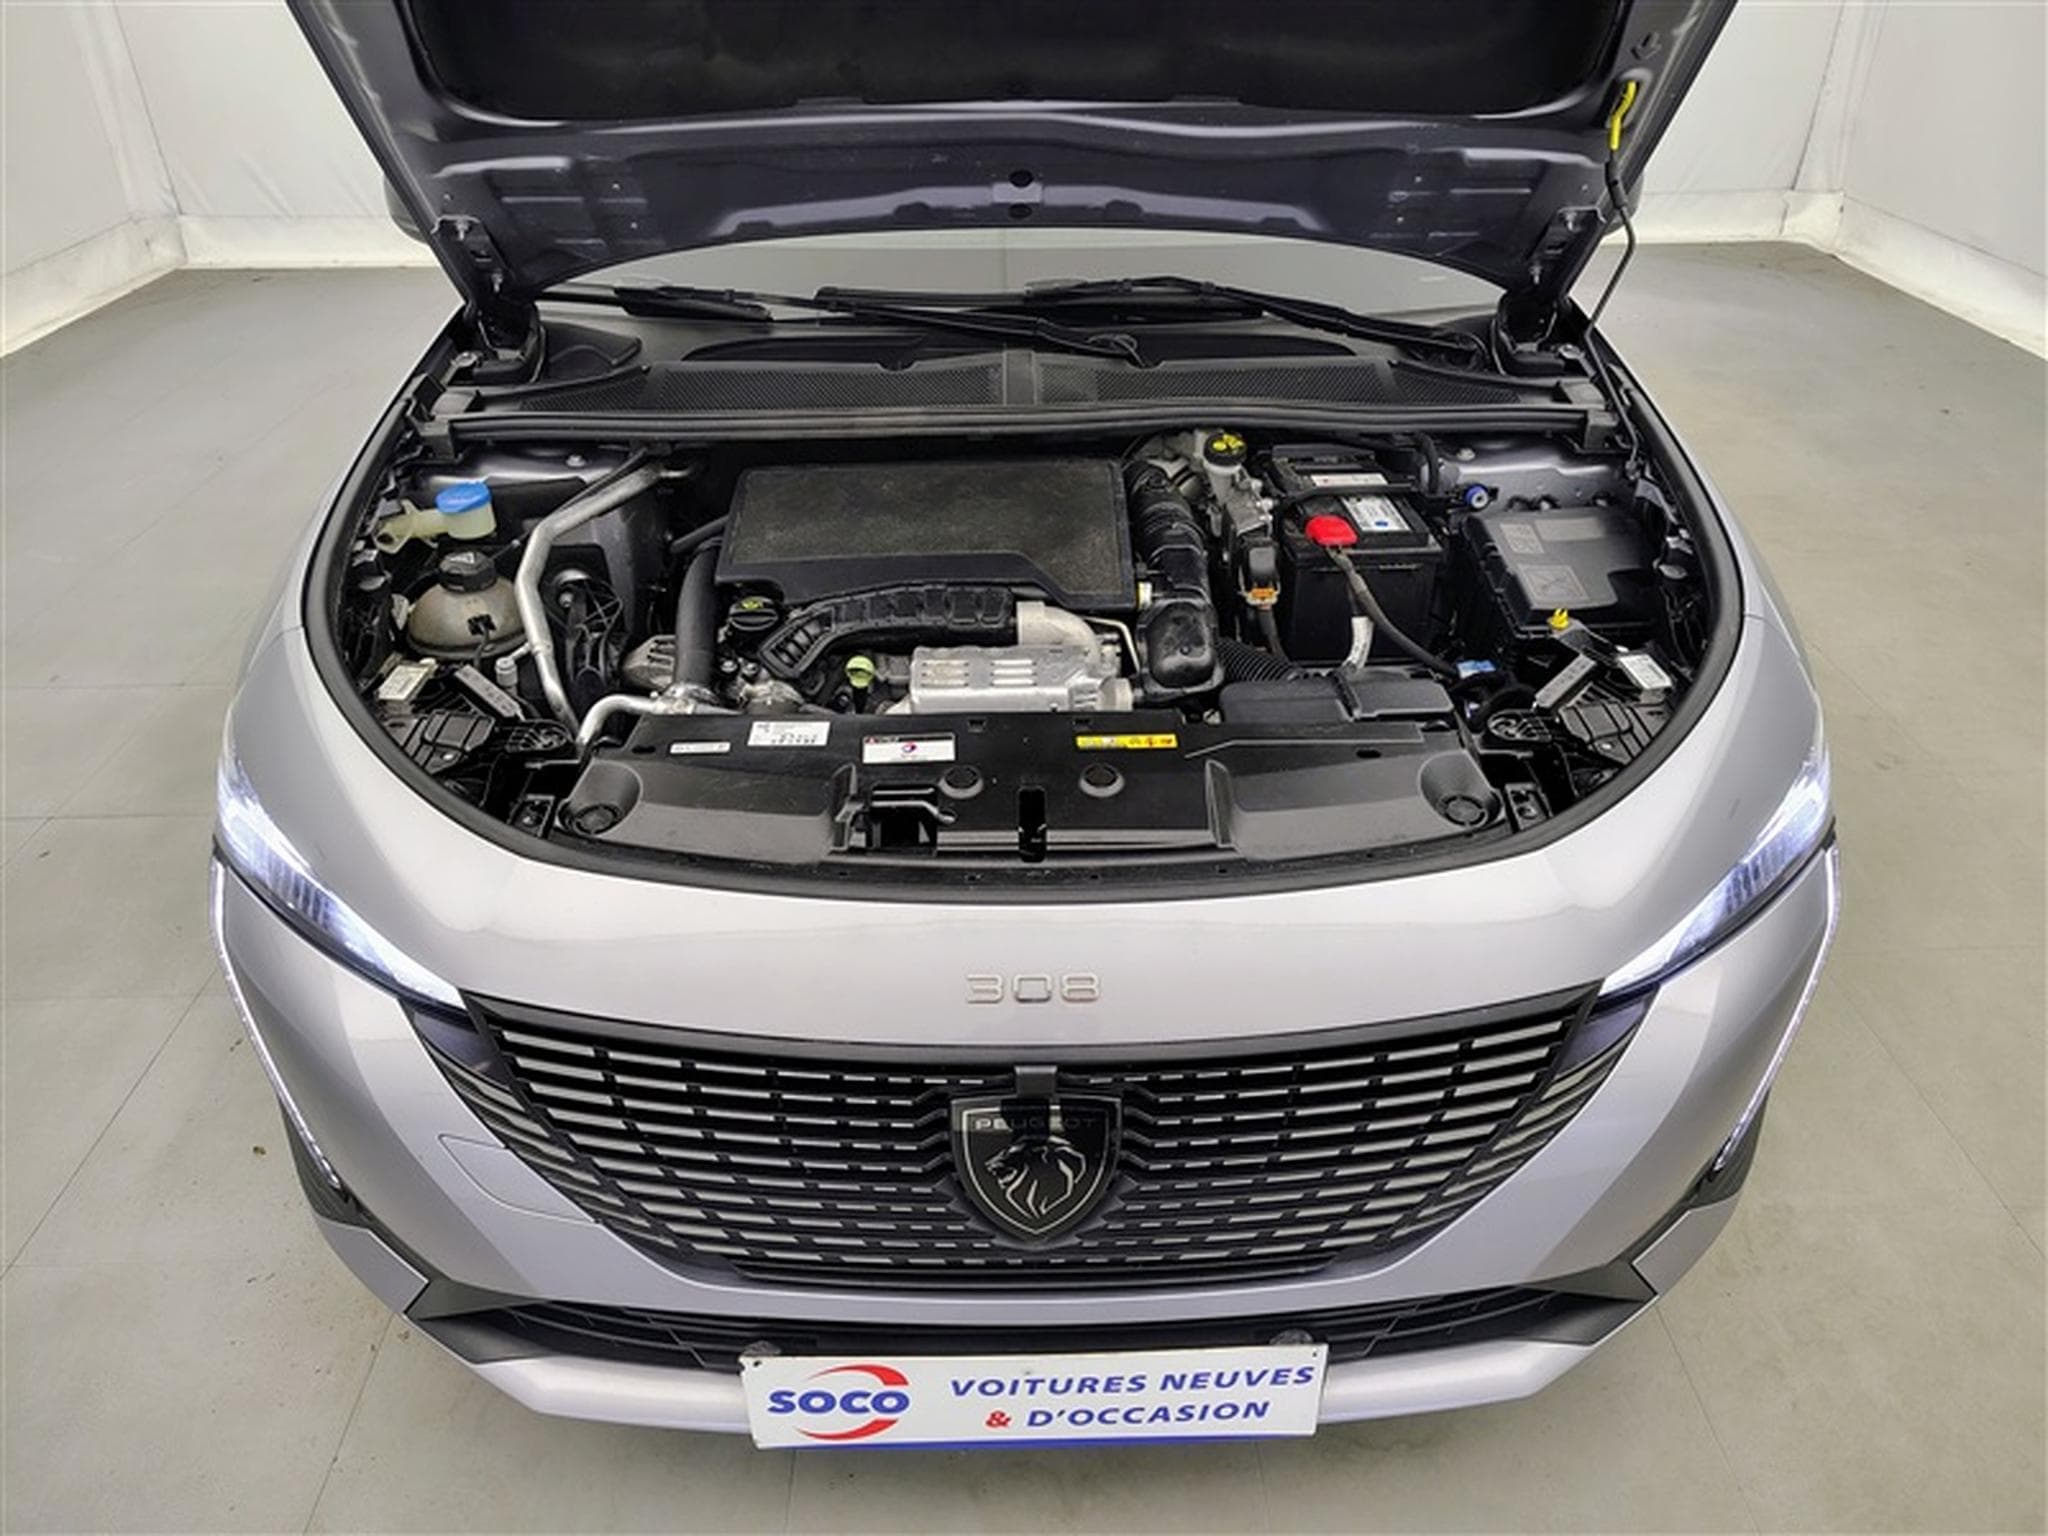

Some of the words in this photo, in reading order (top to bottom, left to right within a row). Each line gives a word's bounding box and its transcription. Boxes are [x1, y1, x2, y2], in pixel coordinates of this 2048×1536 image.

[966, 973, 1100, 1005] 308
[951, 1374, 1147, 1397] VOITURES
[1159, 1366, 1315, 1391] NEUVES
[767, 1389, 910, 1414] SOCO
[985, 1410, 1011, 1428] &
[1027, 1401, 1270, 1427] D'OCCASION
